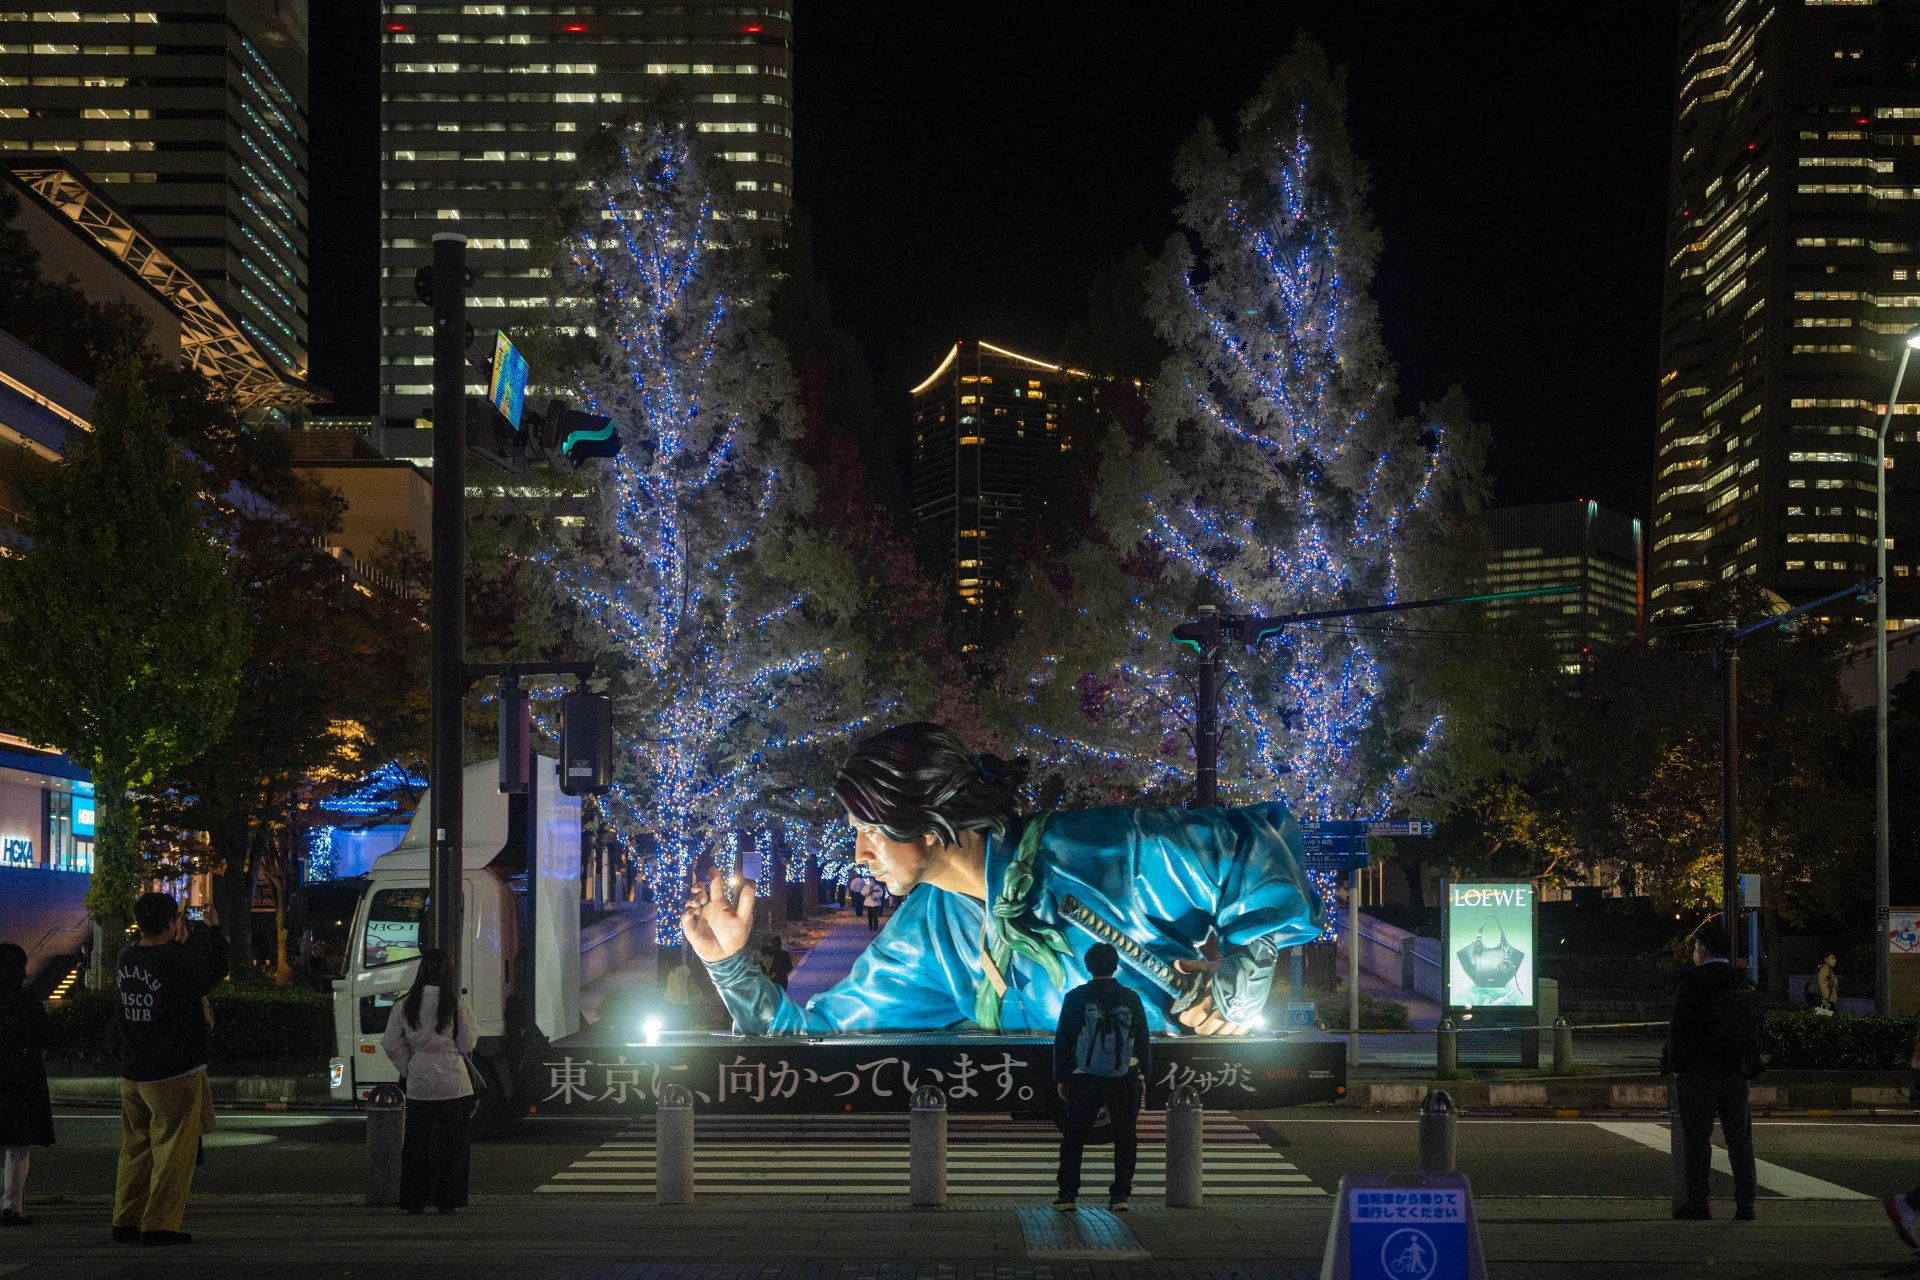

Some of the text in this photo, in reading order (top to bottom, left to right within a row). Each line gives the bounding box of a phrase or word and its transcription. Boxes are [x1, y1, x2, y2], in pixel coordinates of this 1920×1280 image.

[4, 838, 33, 864] HOKA
[1454, 889, 1527, 907] LOEWE
[117, 966, 163, 991] ALAXY
[541, 1053, 1034, 1105] 東京に、向かっています。
[1155, 1062, 1257, 1094] イクサガミ
